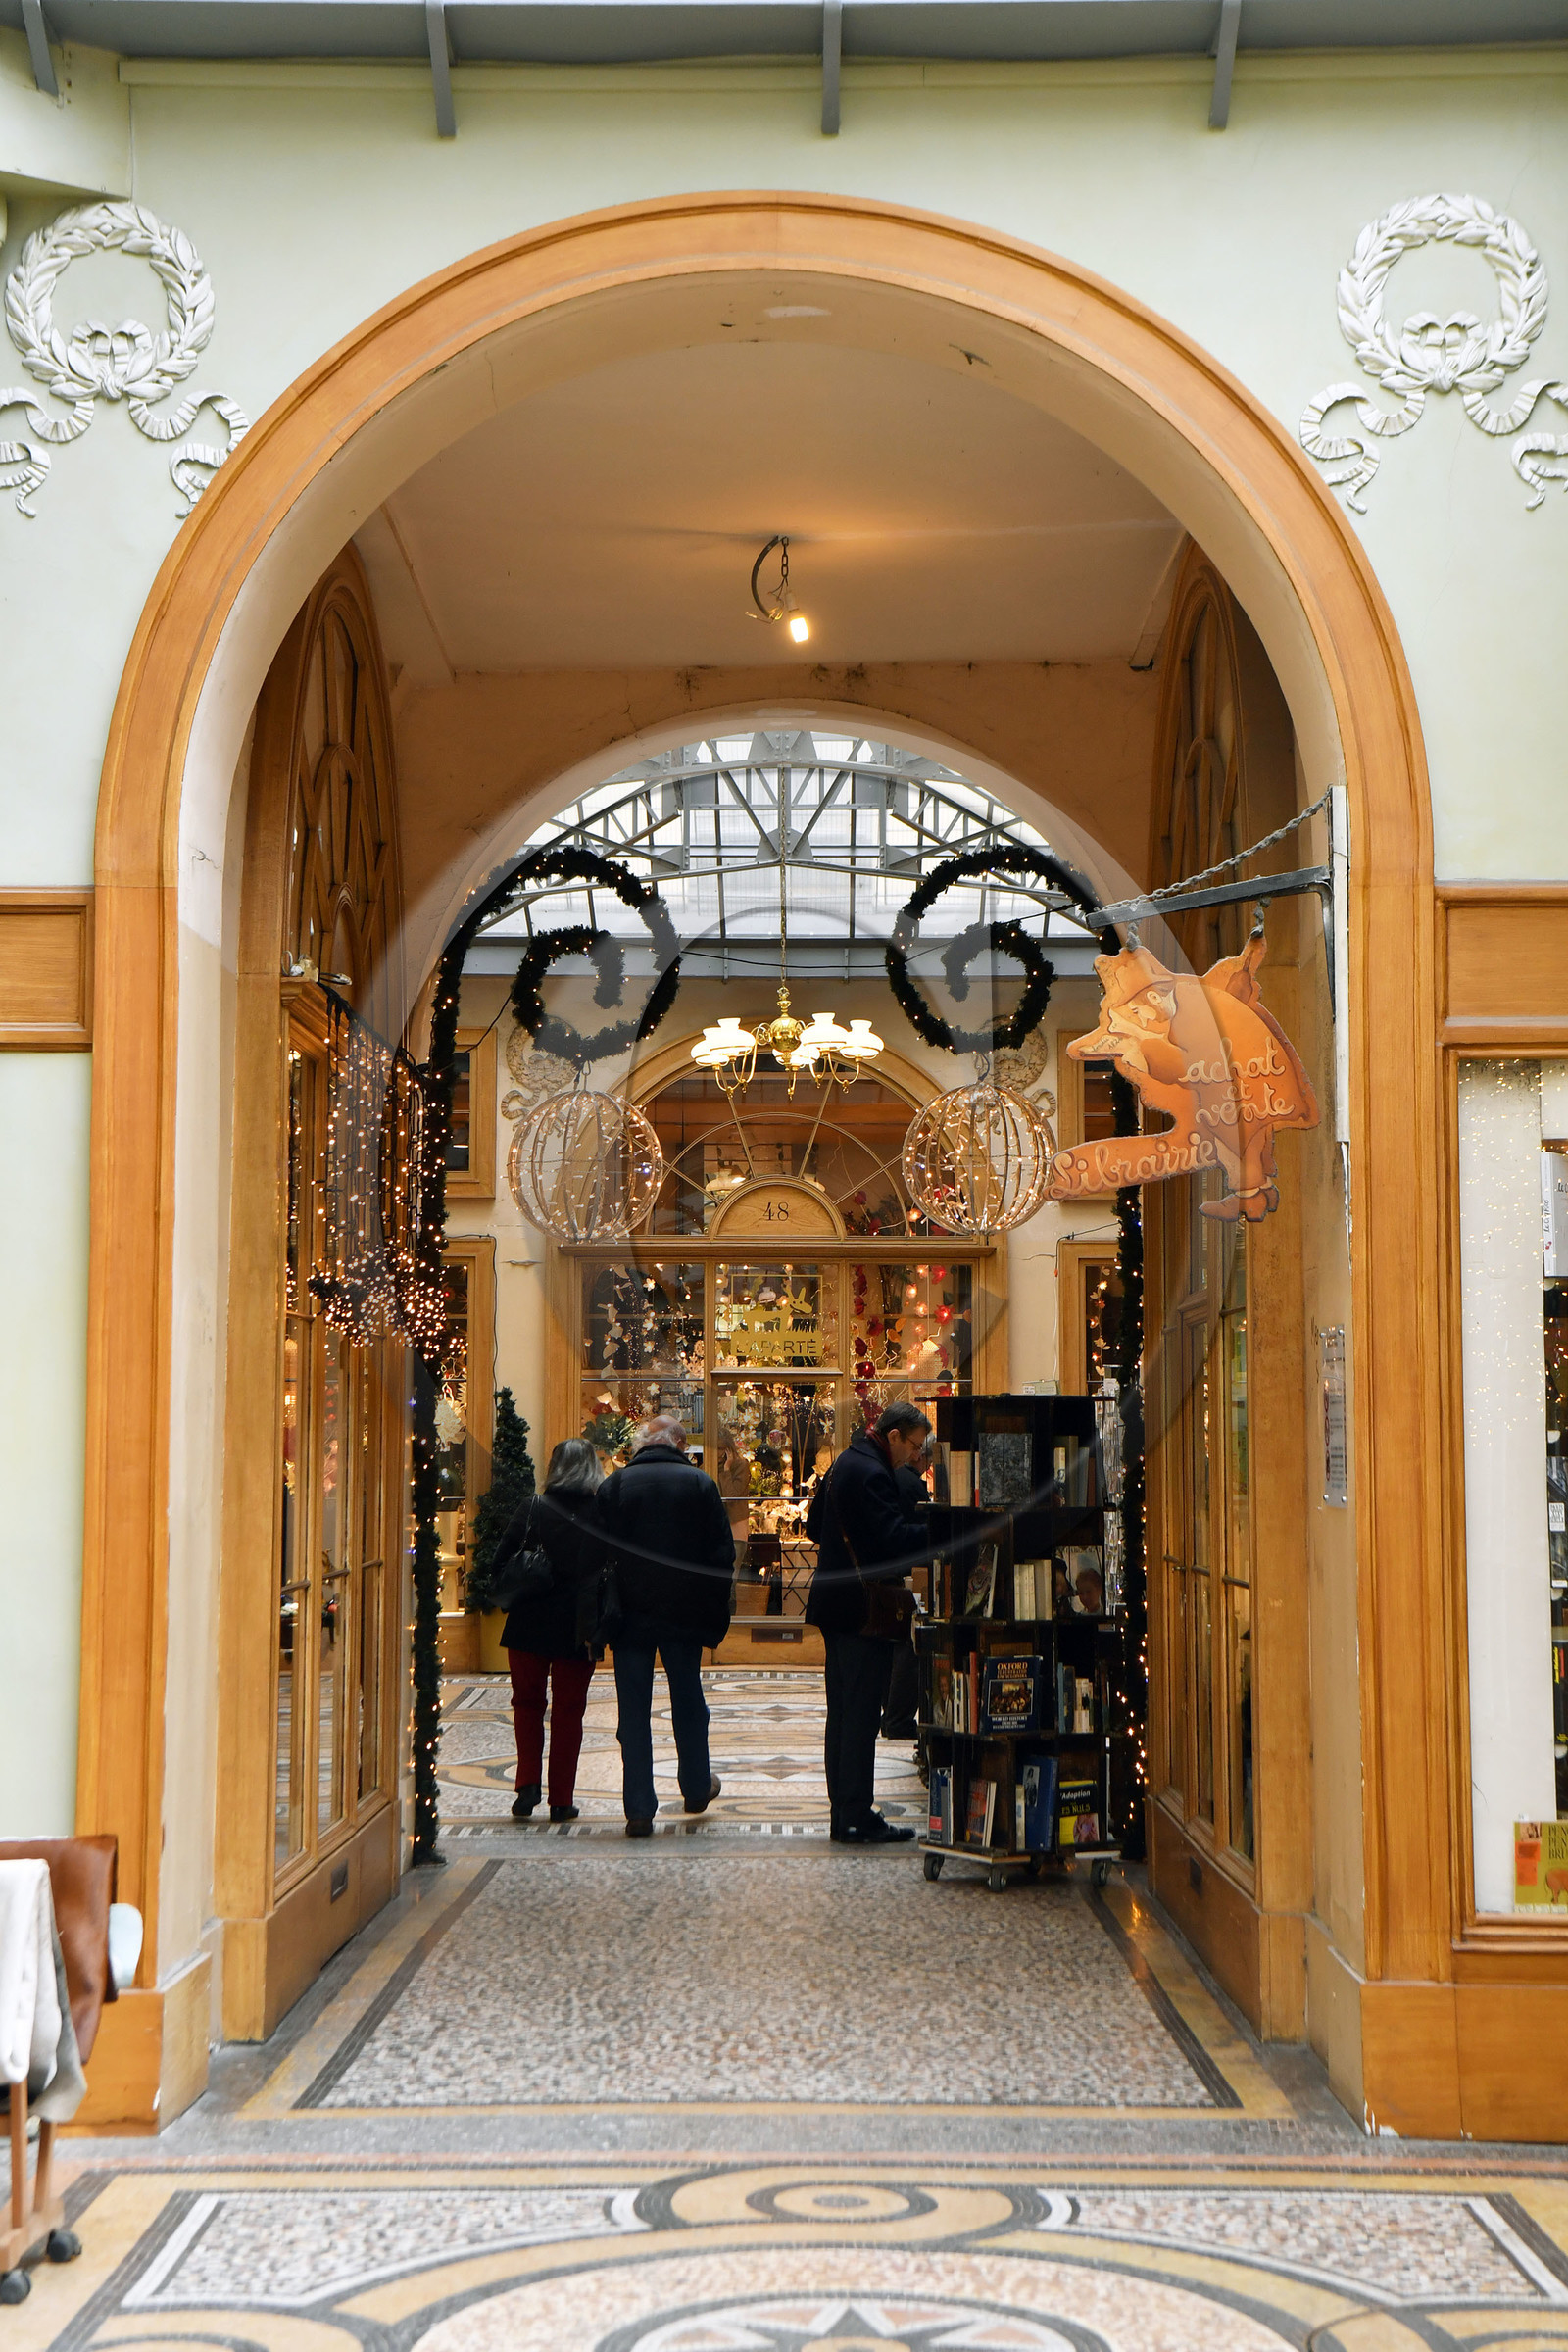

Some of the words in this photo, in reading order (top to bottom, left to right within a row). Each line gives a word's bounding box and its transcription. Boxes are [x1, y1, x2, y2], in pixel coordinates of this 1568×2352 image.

[1177, 1036, 1286, 1083] achat
[1196, 1082, 1296, 1127] vente
[1222, 1079, 1254, 1102] et
[1050, 1132, 1217, 1199] Librairie
[762, 1201, 790, 1222] 48
[997, 1661, 1028, 1671] OXFORD
